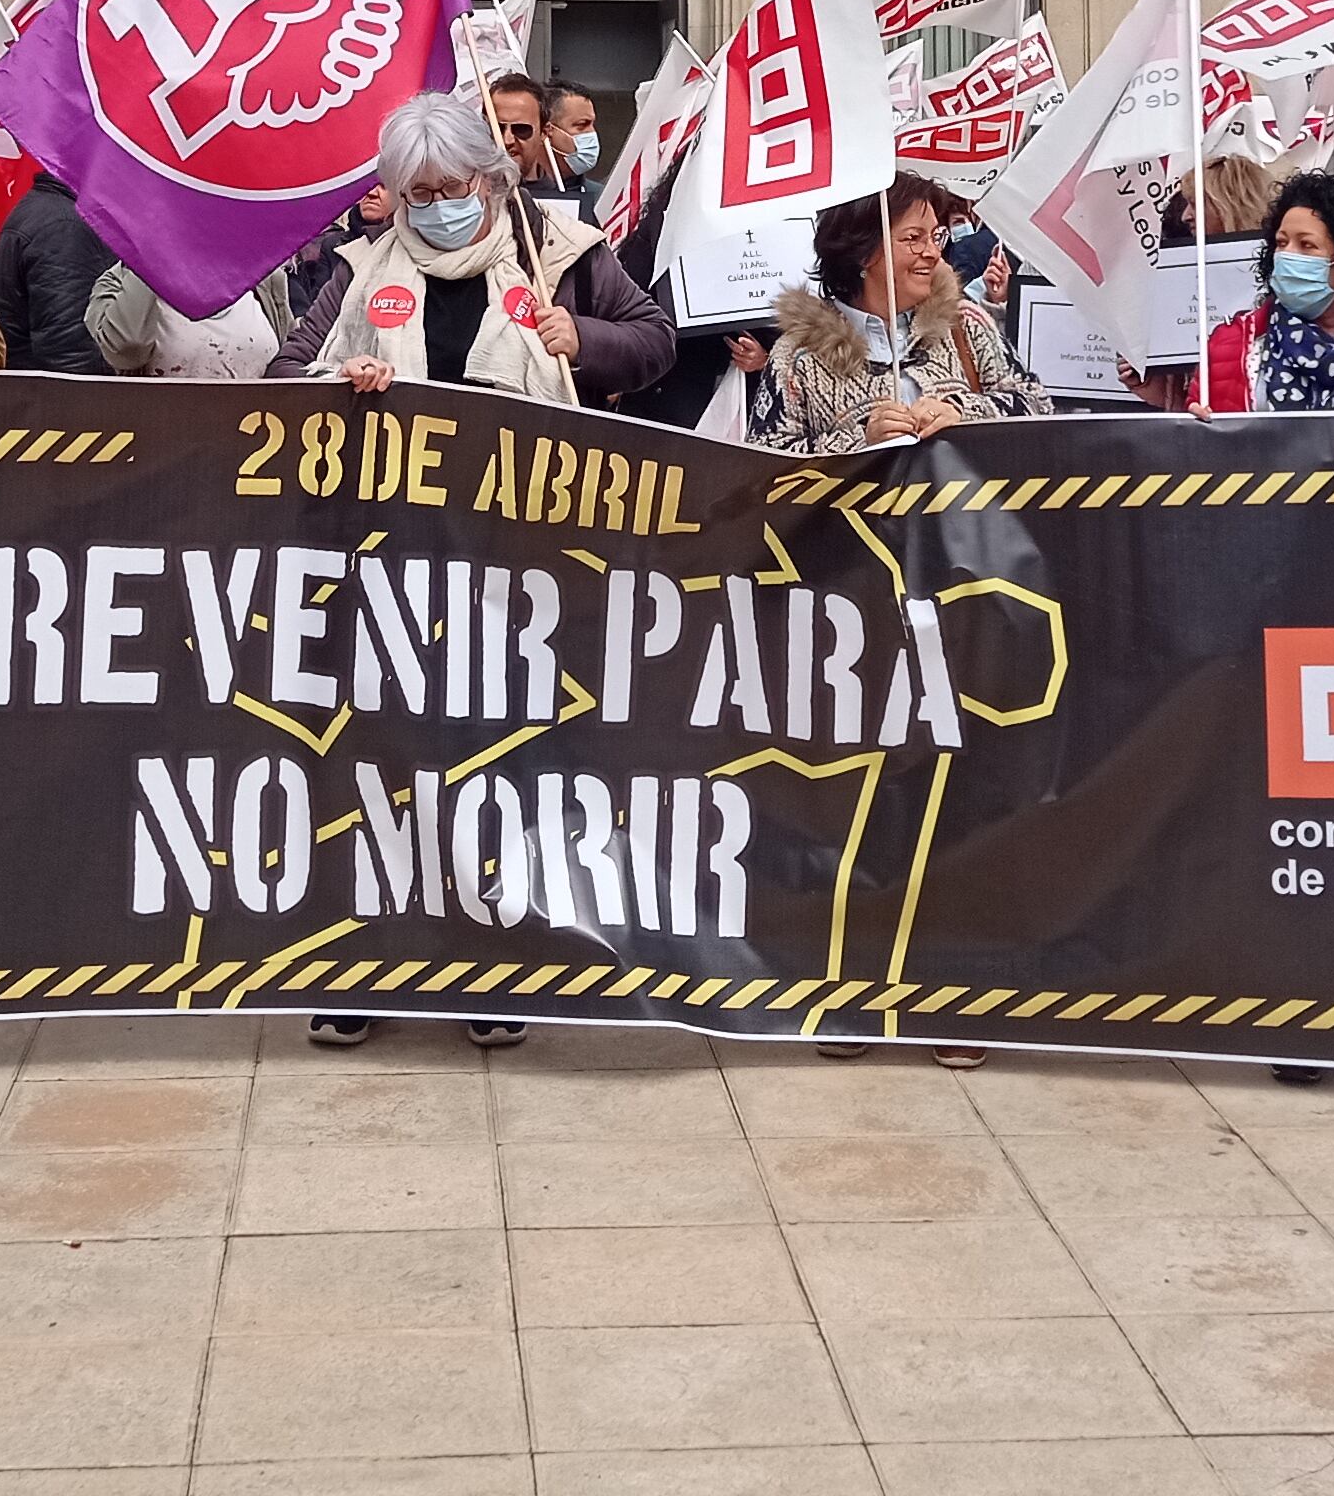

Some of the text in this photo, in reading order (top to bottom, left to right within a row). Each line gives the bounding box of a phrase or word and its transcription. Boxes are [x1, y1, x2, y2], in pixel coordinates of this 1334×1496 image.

[235, 410, 701, 534] 28 DE ABRIL
[602, 569, 963, 748] PARA
[131, 755, 752, 939] NO MORIR
[1270, 858, 1325, 896] de
